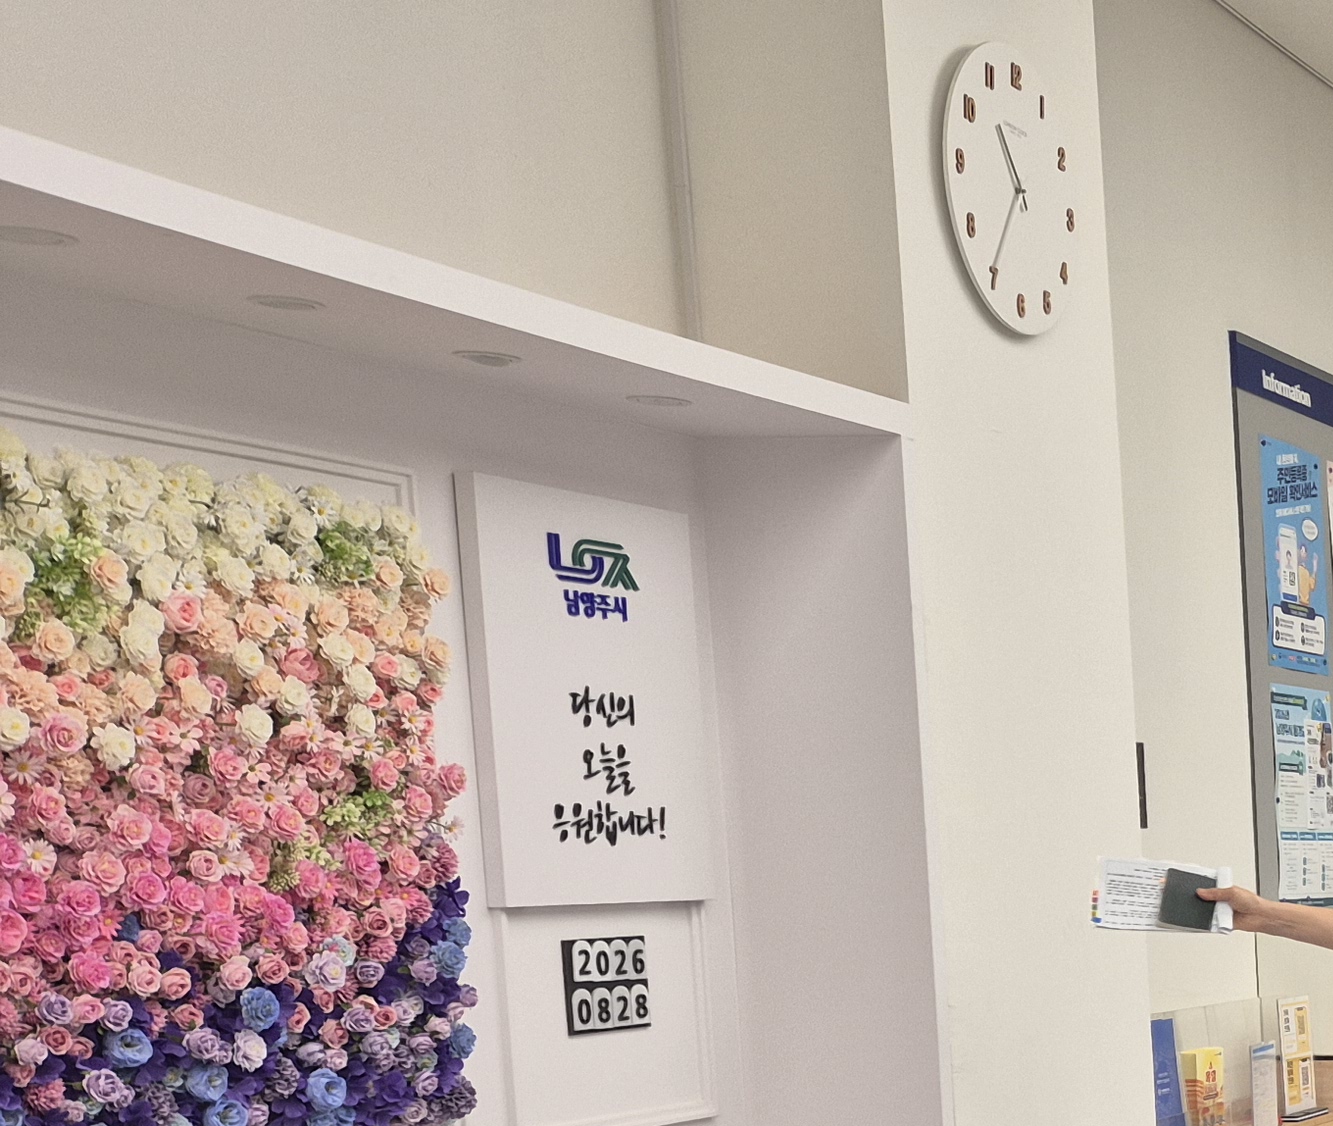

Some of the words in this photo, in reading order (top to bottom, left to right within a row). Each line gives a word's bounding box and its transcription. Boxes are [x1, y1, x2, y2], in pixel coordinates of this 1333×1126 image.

[984, 62, 994, 90] 11
[1010, 62, 1022, 91] 12
[963, 93, 976, 123] 10
[1039, 95, 1045, 120] 1
[955, 148, 965, 174] 9
[1057, 146, 1066, 172] 2
[966, 212, 976, 239] 8
[1066, 208, 1075, 232] 3
[989, 266, 998, 290] 7
[1059, 261, 1068, 285] 4
[1017, 293, 1026, 318] 6
[1043, 290, 1051, 315] 5
[1262, 369, 1311, 407] Information
[563, 589, 628, 622] 남양주시
[568, 685, 635, 728] 당신의
[582, 742, 635, 796] 오늘을
[552, 800, 666, 846] 응원합니다!
[578, 949, 645, 976] 2026
[577, 994, 648, 1025] 0828
